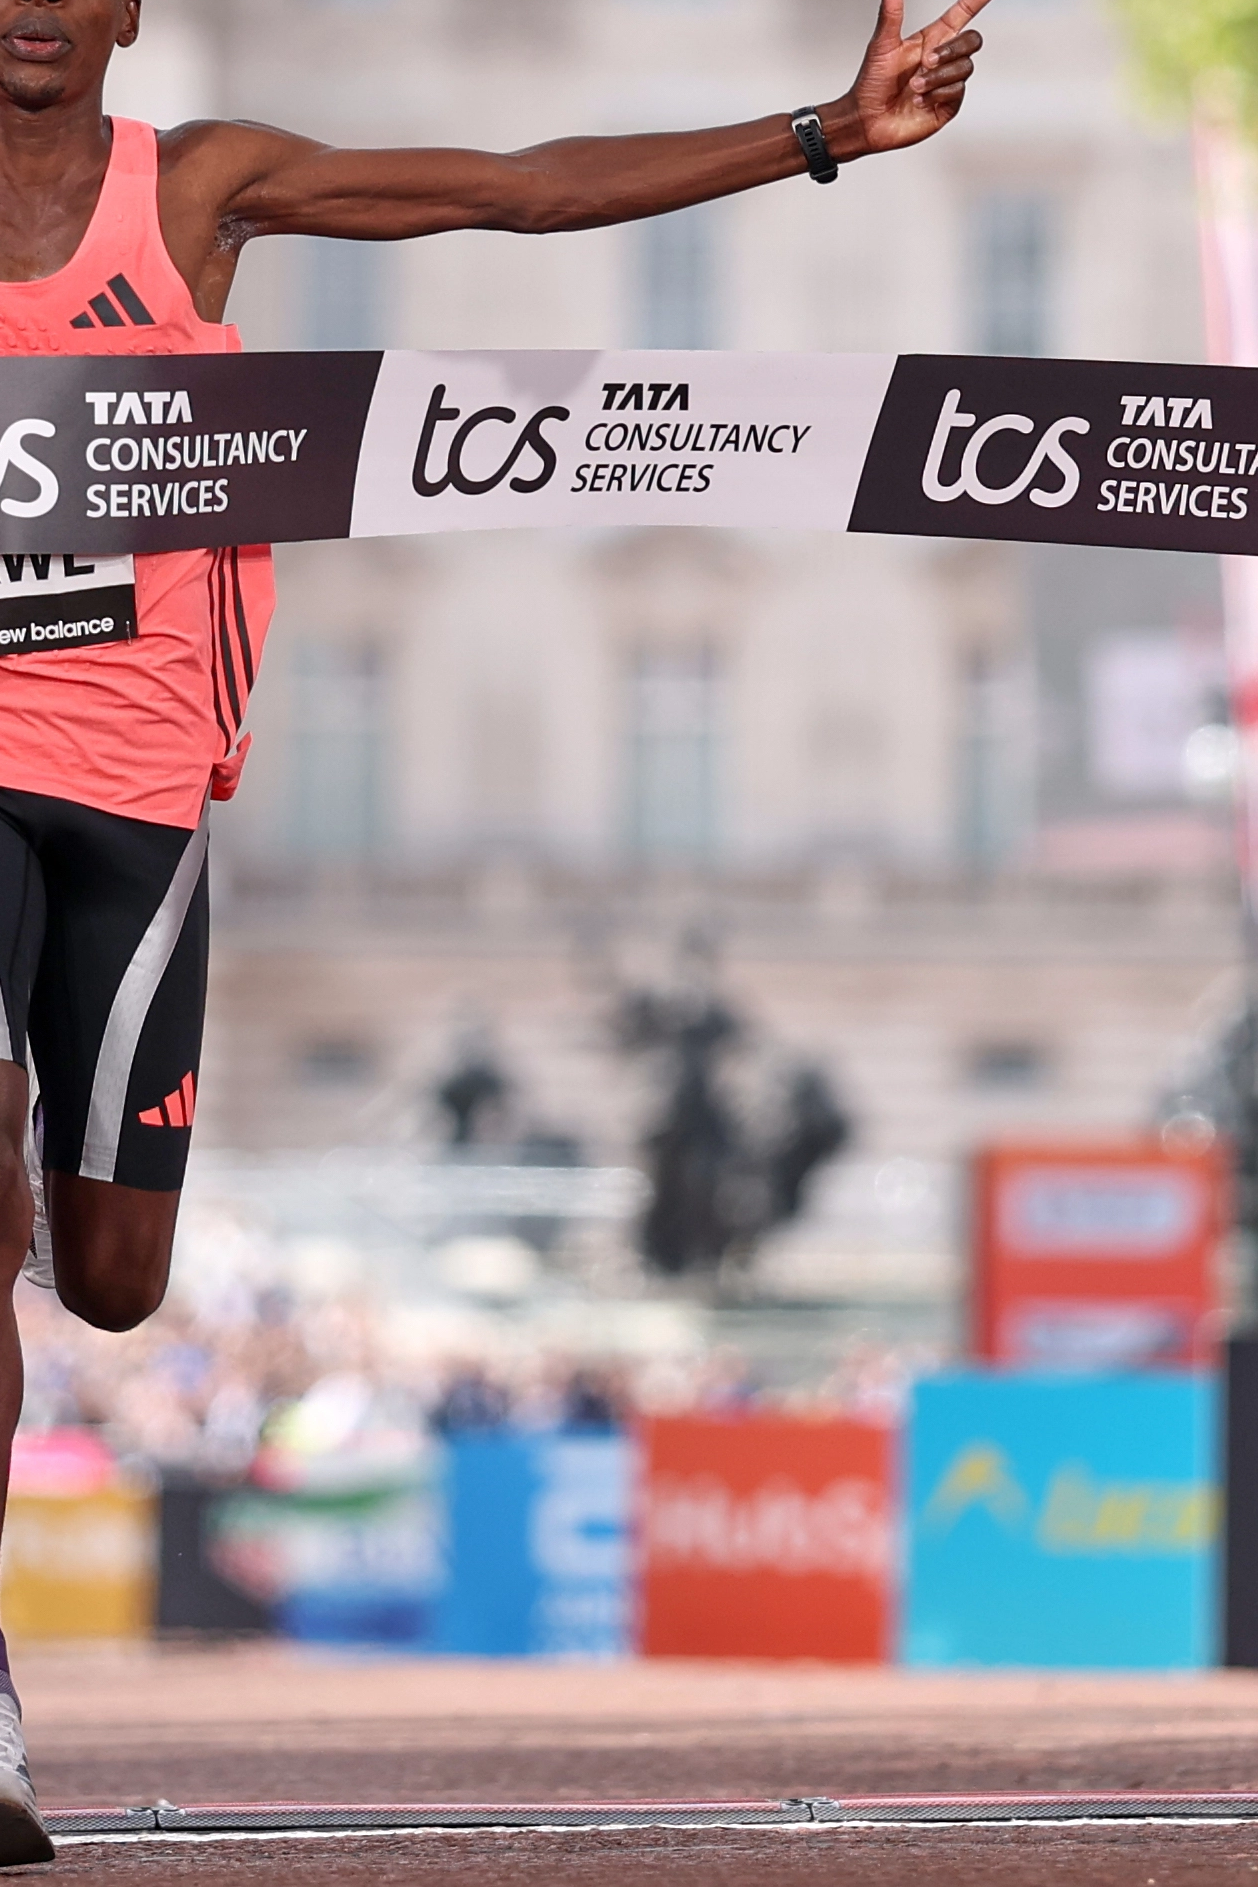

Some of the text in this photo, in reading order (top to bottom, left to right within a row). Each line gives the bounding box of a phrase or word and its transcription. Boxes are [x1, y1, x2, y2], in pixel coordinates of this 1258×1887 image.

[85, 390, 193, 425] TATA
[601, 382, 690, 411] TATA
[1121, 395, 1213, 429] TATA
[85, 428, 308, 472] CONSULTANCY
[411, 383, 571, 498] tcs
[585, 422, 812, 454] CONSULTANCY
[921, 388, 1091, 508] tcs
[570, 463, 715, 493] SERVICES
[86, 478, 230, 518] SERVICES
[1096, 479, 1249, 520] SERVICES
[30, 616, 115, 642] balance
